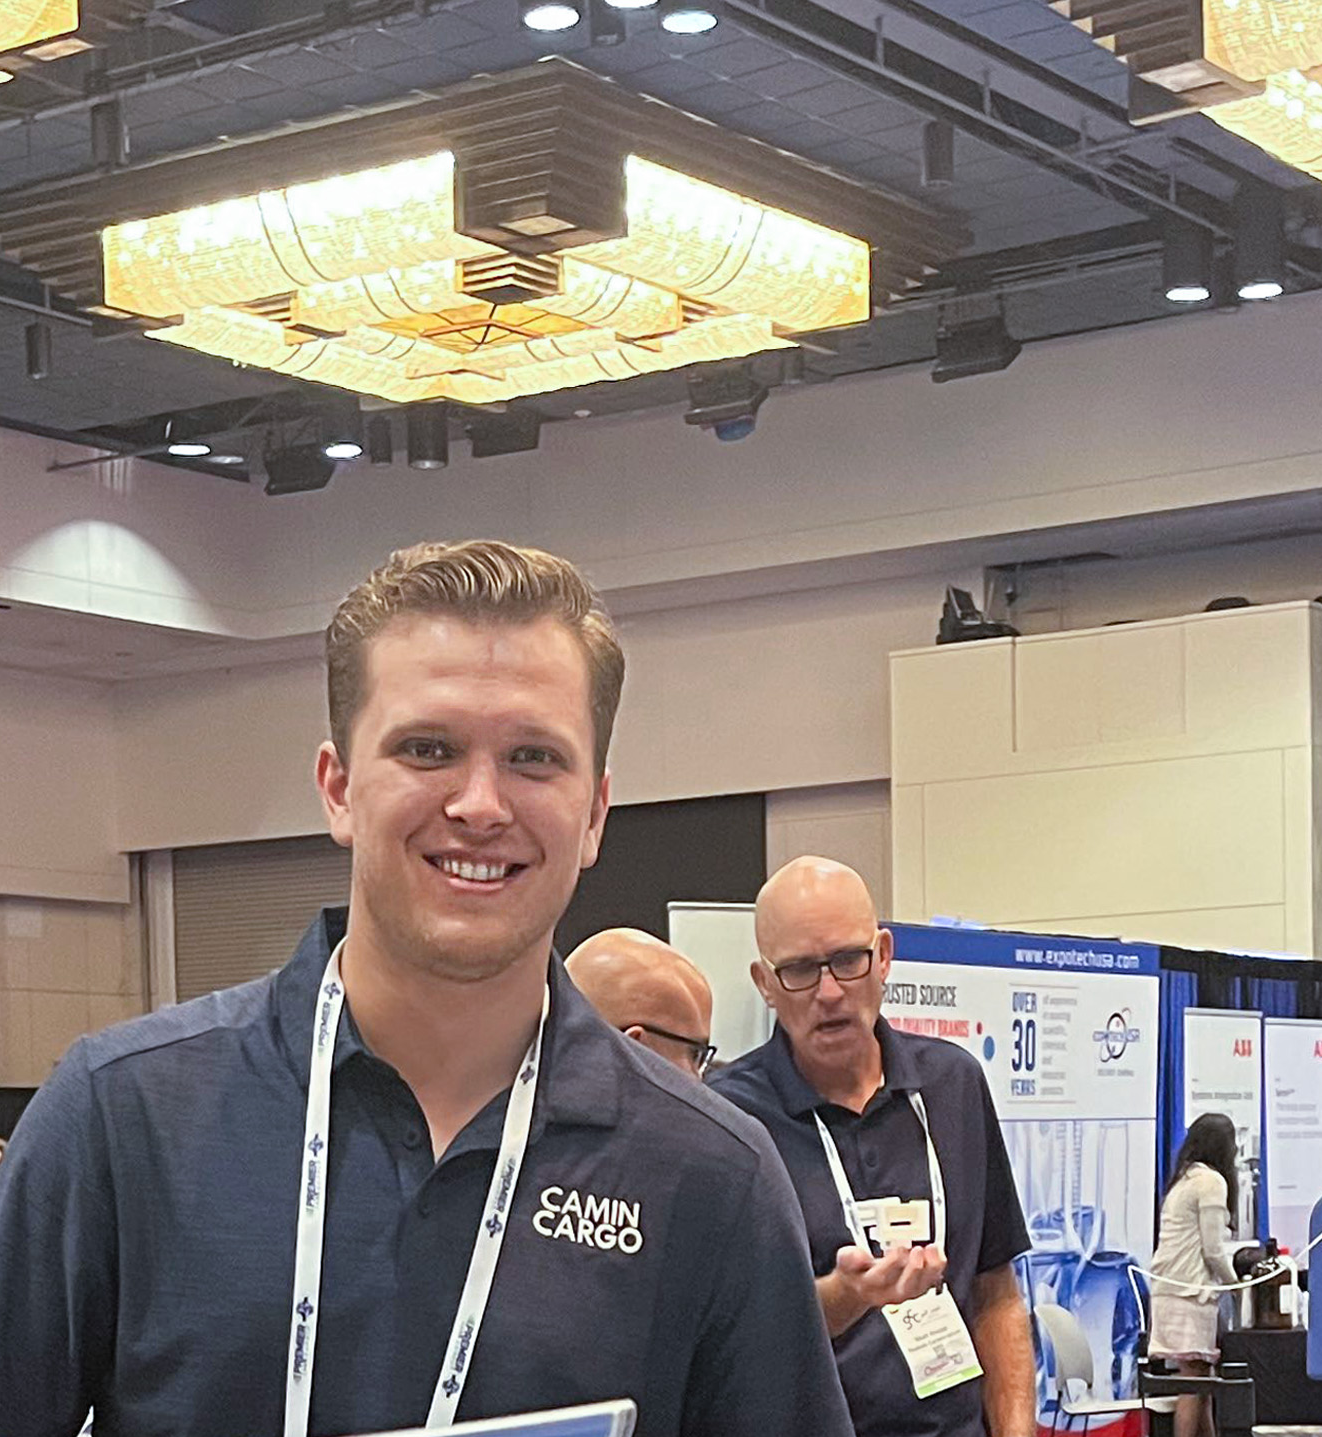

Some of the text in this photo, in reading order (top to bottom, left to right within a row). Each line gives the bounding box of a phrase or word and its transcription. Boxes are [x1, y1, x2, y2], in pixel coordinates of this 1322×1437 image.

[919, 984, 957, 1008] SOURCE
[1011, 1018, 1036, 1072] 30
[1233, 1039, 1253, 1057] ABB
[540, 1186, 640, 1229] CAMIN
[532, 1210, 643, 1255] CARGO
